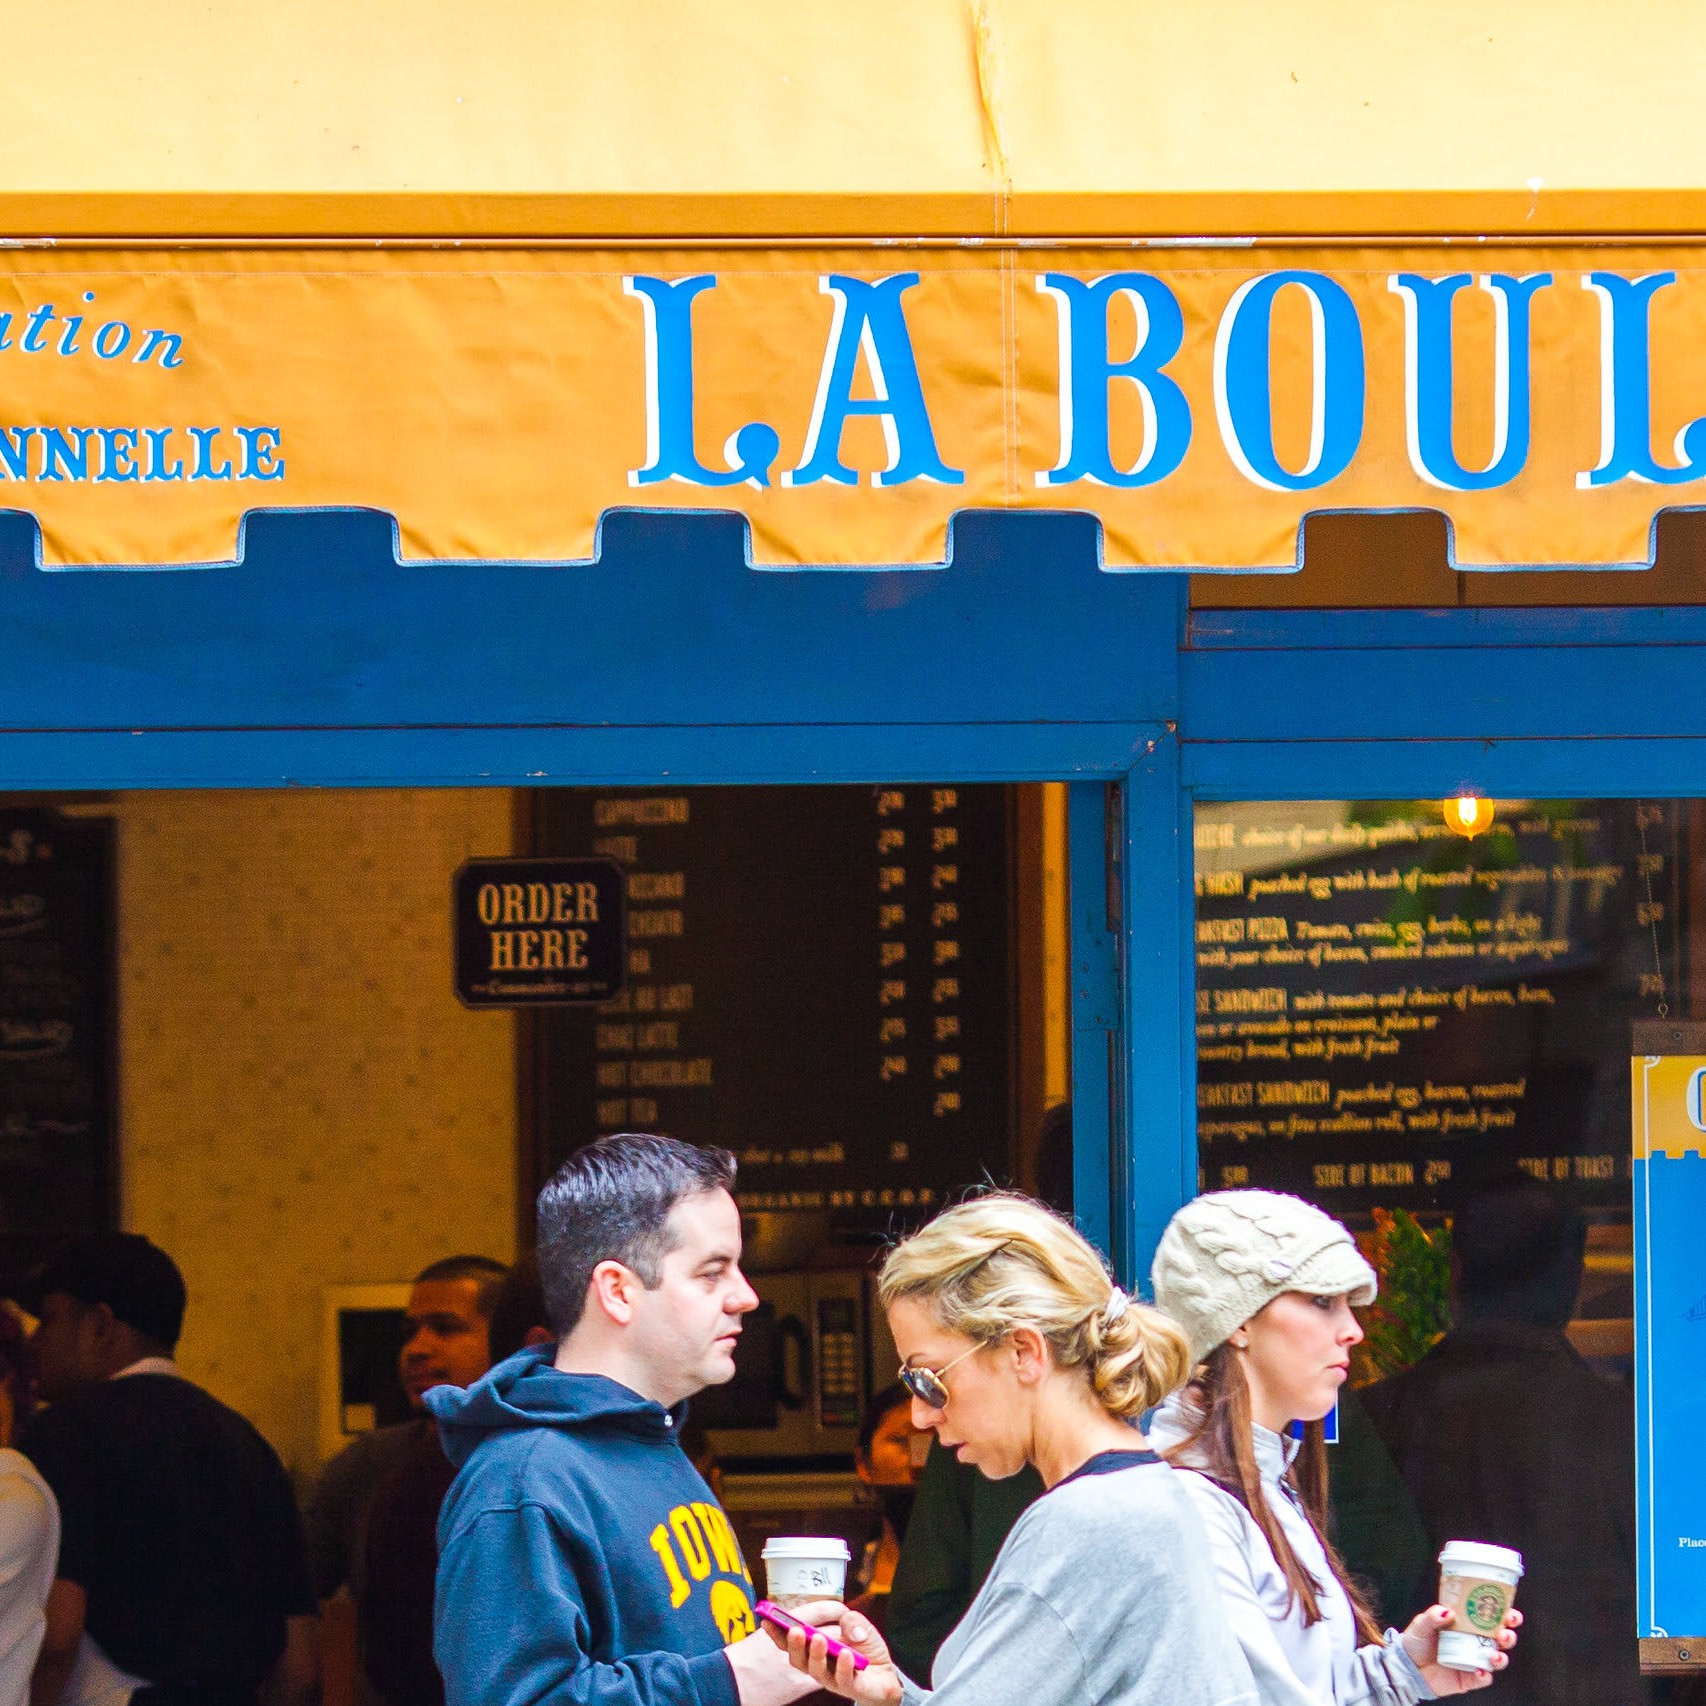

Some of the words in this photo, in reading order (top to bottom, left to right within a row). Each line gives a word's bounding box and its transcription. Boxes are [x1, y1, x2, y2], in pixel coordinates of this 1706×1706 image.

[621, 272, 966, 492] LA
[477, 881, 600, 925] ORDER
[488, 930, 590, 971] HERE
[649, 1502, 753, 1609] IOW
